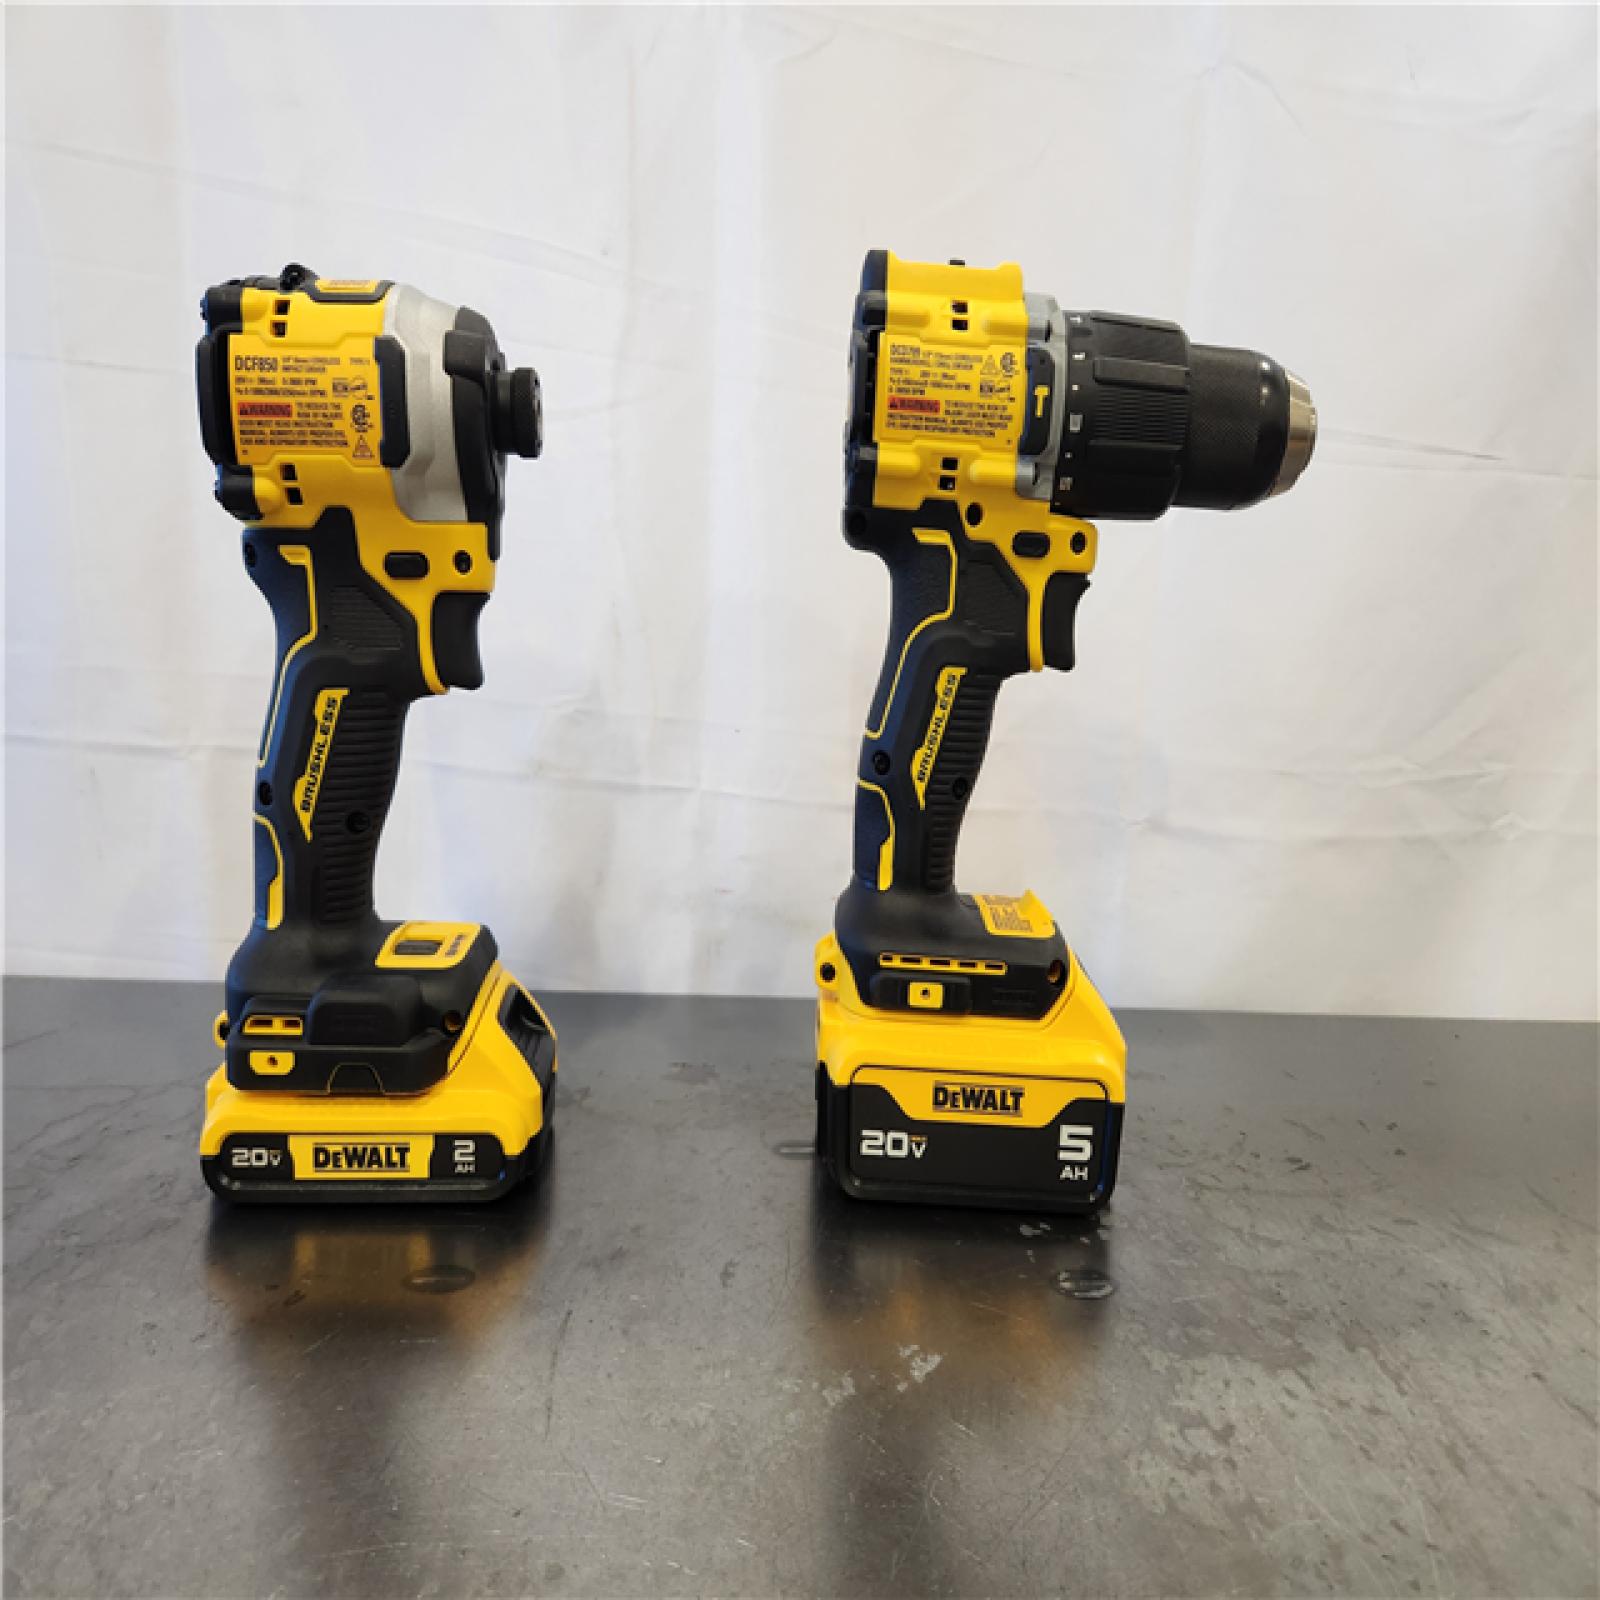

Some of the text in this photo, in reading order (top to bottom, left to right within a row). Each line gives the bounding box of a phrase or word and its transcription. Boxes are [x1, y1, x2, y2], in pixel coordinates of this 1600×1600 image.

[234, 355, 278, 372] DCF850
[916, 674, 957, 782] BRUSHLESS
[300, 696, 338, 813] BRUSHLESS
[453, 1138, 476, 1162] 2
[1057, 1124, 1094, 1162] 5
[1059, 1165, 1089, 1181] AH
